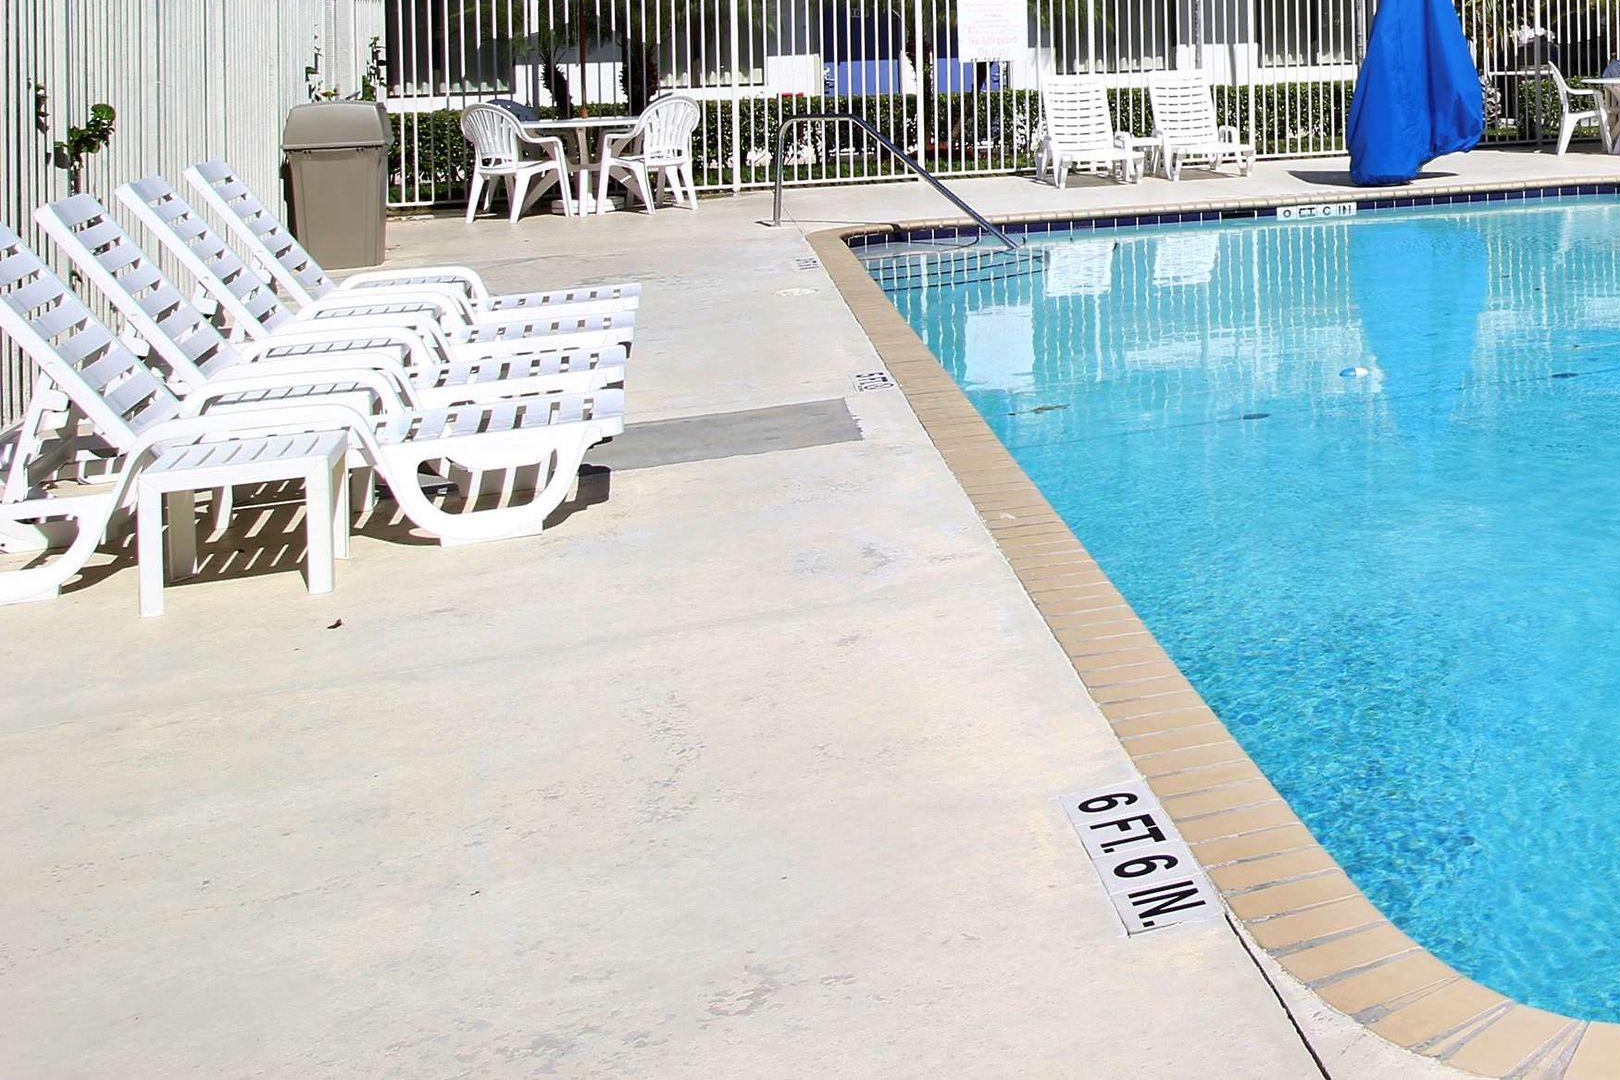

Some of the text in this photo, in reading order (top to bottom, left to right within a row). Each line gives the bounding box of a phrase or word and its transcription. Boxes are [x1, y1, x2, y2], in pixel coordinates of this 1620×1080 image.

[1078, 792, 1206, 927] 6 FT. 6 IN.
